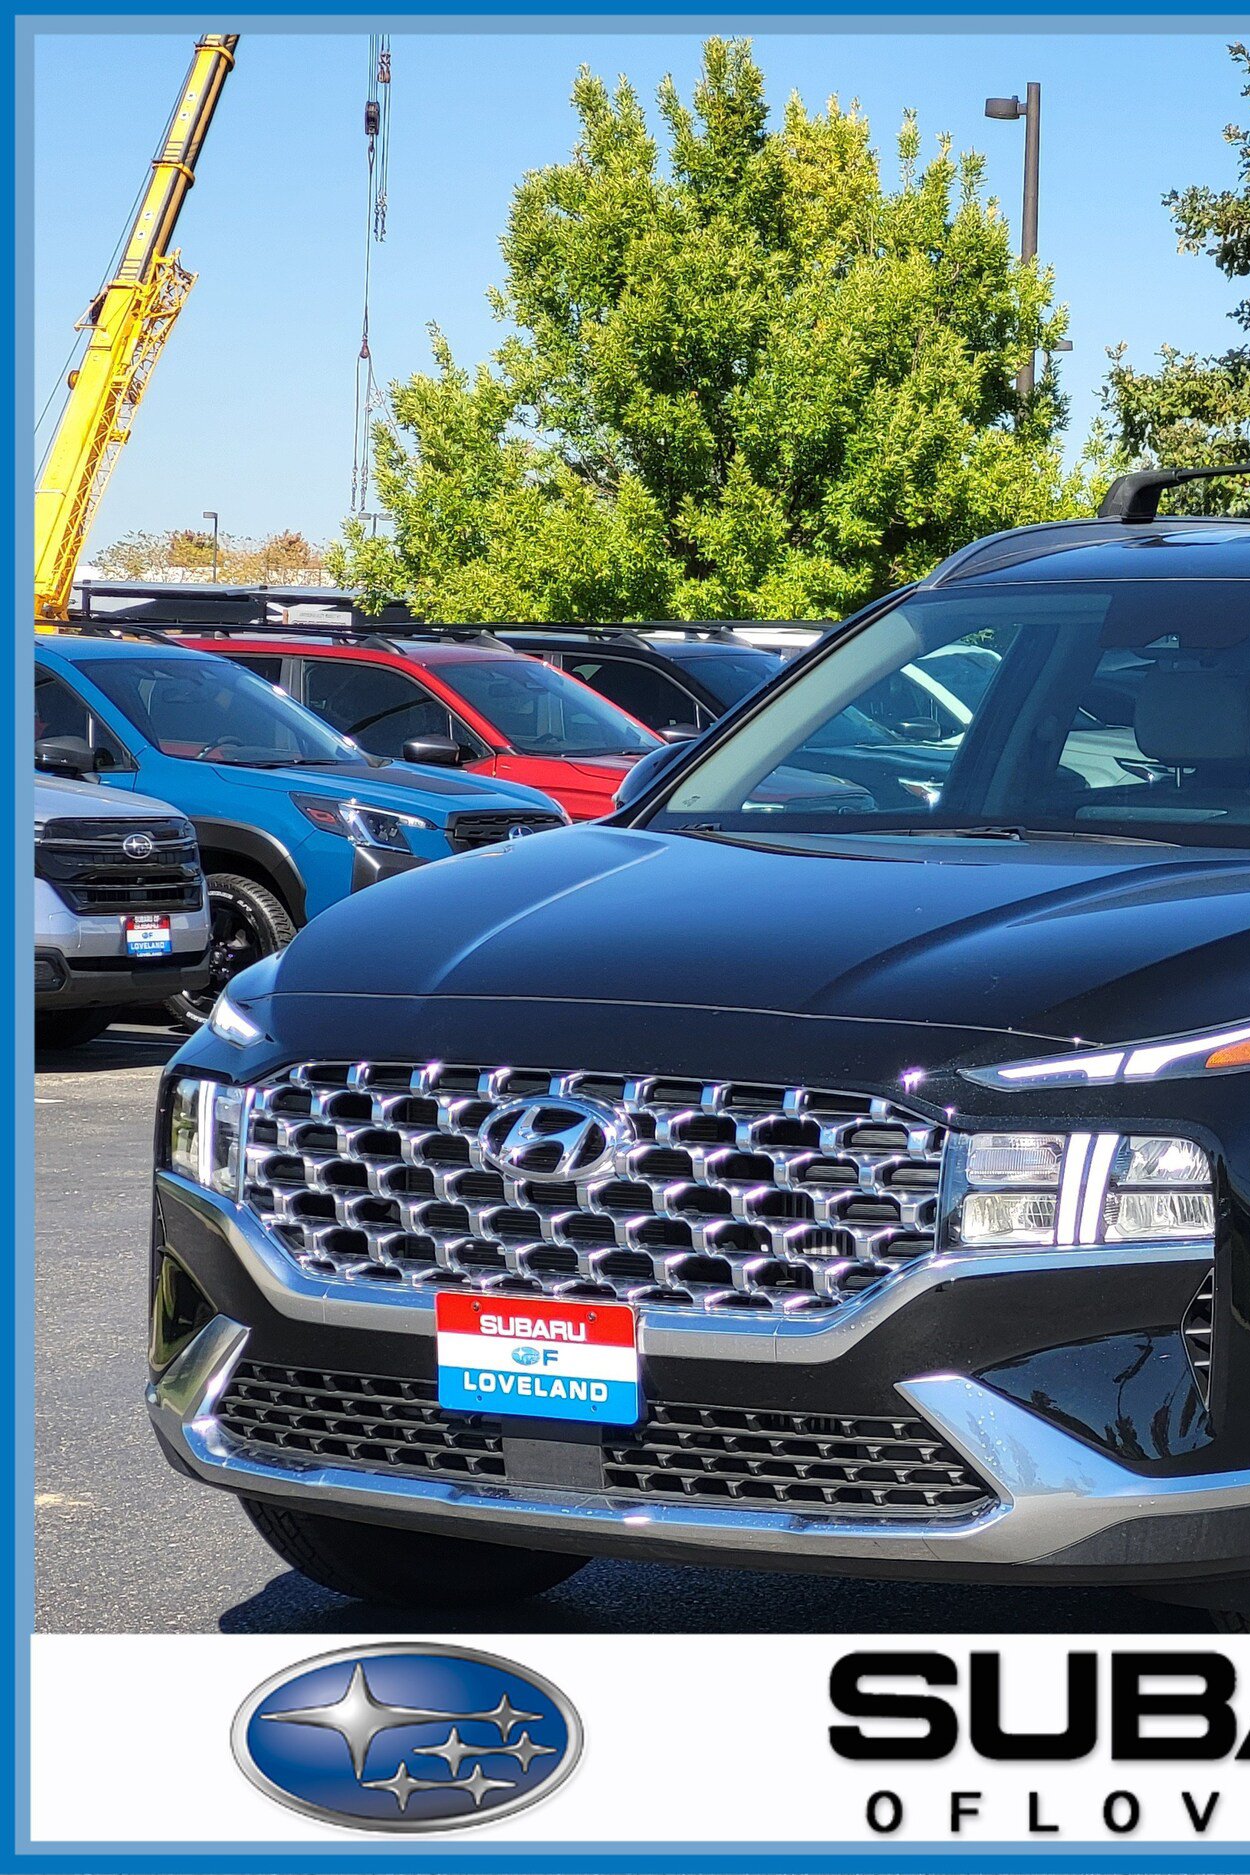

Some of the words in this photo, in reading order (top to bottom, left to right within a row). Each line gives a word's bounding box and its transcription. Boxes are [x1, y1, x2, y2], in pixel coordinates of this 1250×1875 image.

[130, 941, 165, 950] LOVELAND
[480, 1314, 586, 1342] SUBARU
[463, 1371, 608, 1403] LOVELAND
